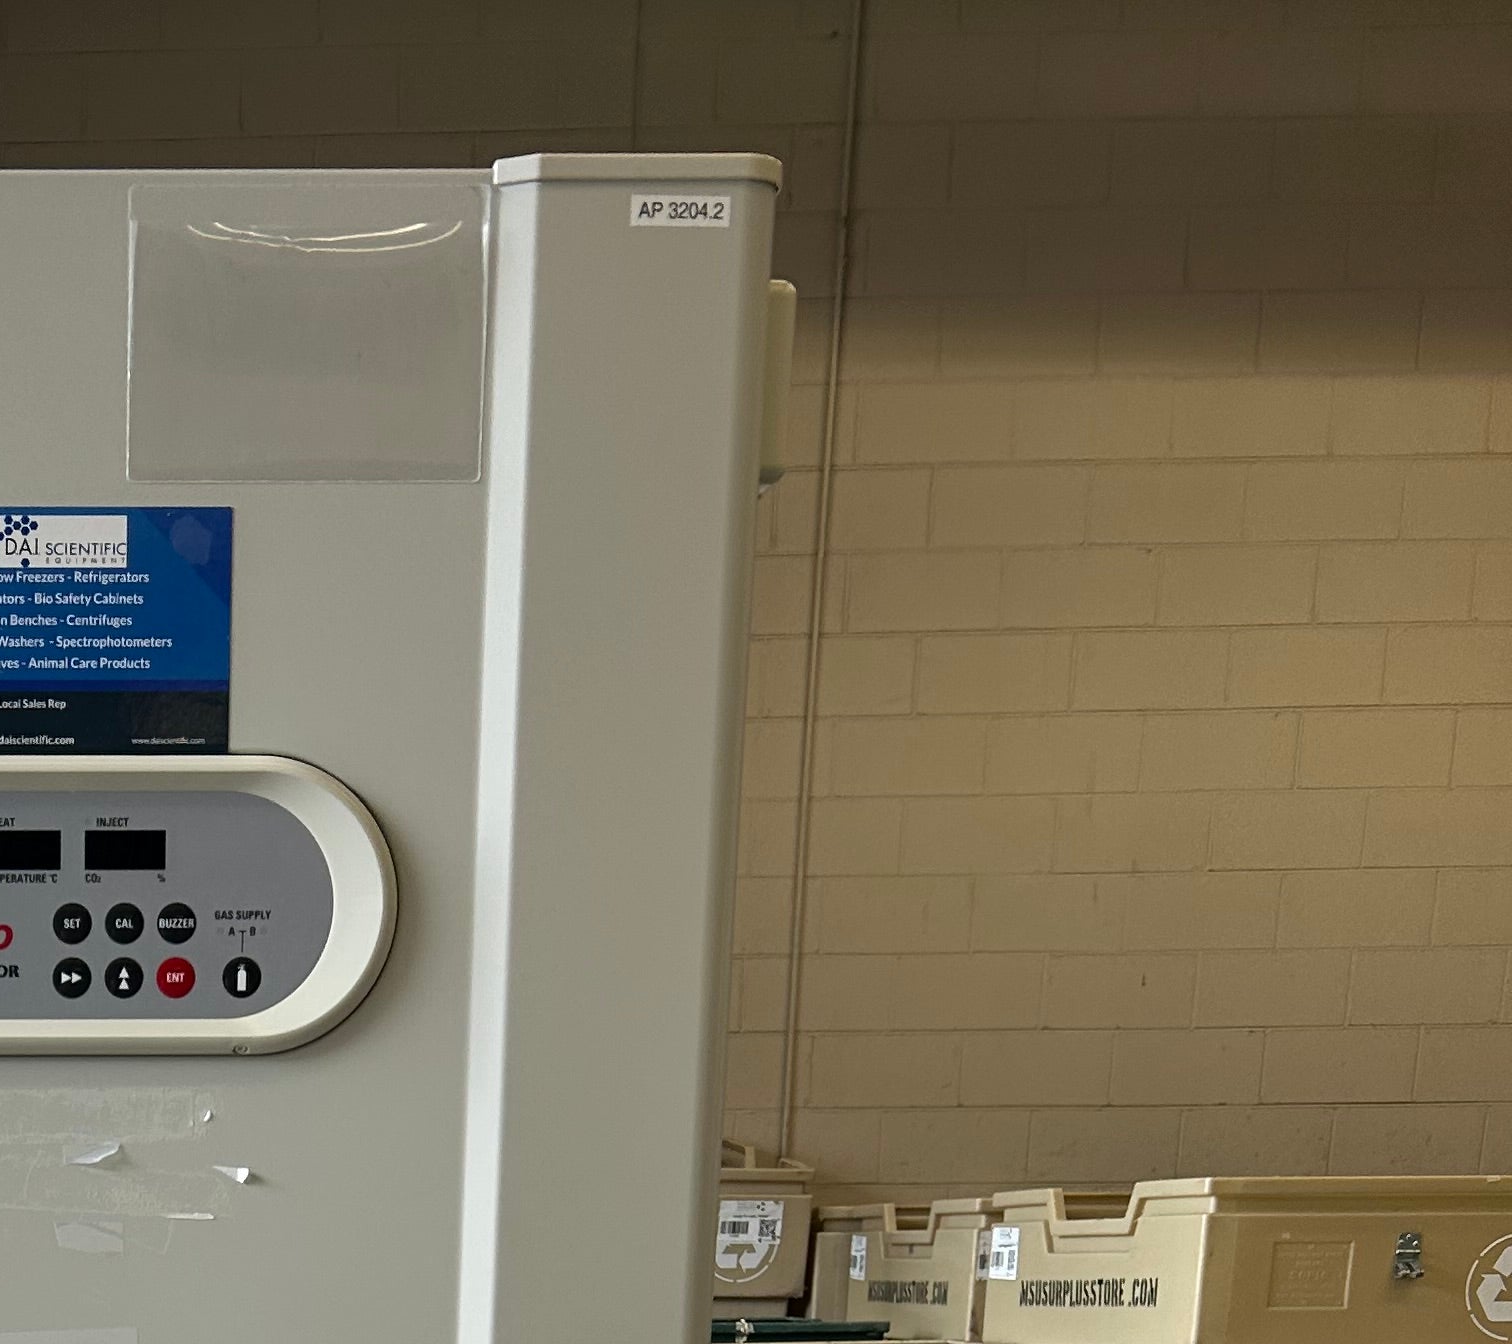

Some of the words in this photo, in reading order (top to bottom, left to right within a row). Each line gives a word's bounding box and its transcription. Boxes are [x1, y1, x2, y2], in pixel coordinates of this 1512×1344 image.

[639, 202, 664, 218] AP
[668, 202, 724, 220] 3204.2
[45, 542, 127, 556] SCIENTIFIC
[16, 571, 65, 583] Freezers
[74, 571, 149, 586] Refrigerators
[34, 593, 53, 605] Bio
[55, 593, 91, 607] Safety
[93, 593, 143, 605] Cabinets
[10, 614, 58, 626] Benches
[66, 614, 132, 628] Centrifuges
[56, 636, 173, 650] Spectrophotometers
[28, 657, 69, 669] Animal
[70, 657, 98, 669] Care
[100, 657, 151, 669] Products
[23, 699, 46, 709] Sales
[48, 699, 66, 711] Rep
[96, 817, 129, 828] INJECT
[214, 910, 234, 920] GAS
[236, 910, 271, 920] SUPPLY
[63, 918, 81, 929] SET
[115, 918, 133, 929] CAL
[158, 917, 195, 929] BUZZER
[228, 927, 235, 936] A
[249, 927, 256, 936] B
[166, 972, 185, 983] ENT
